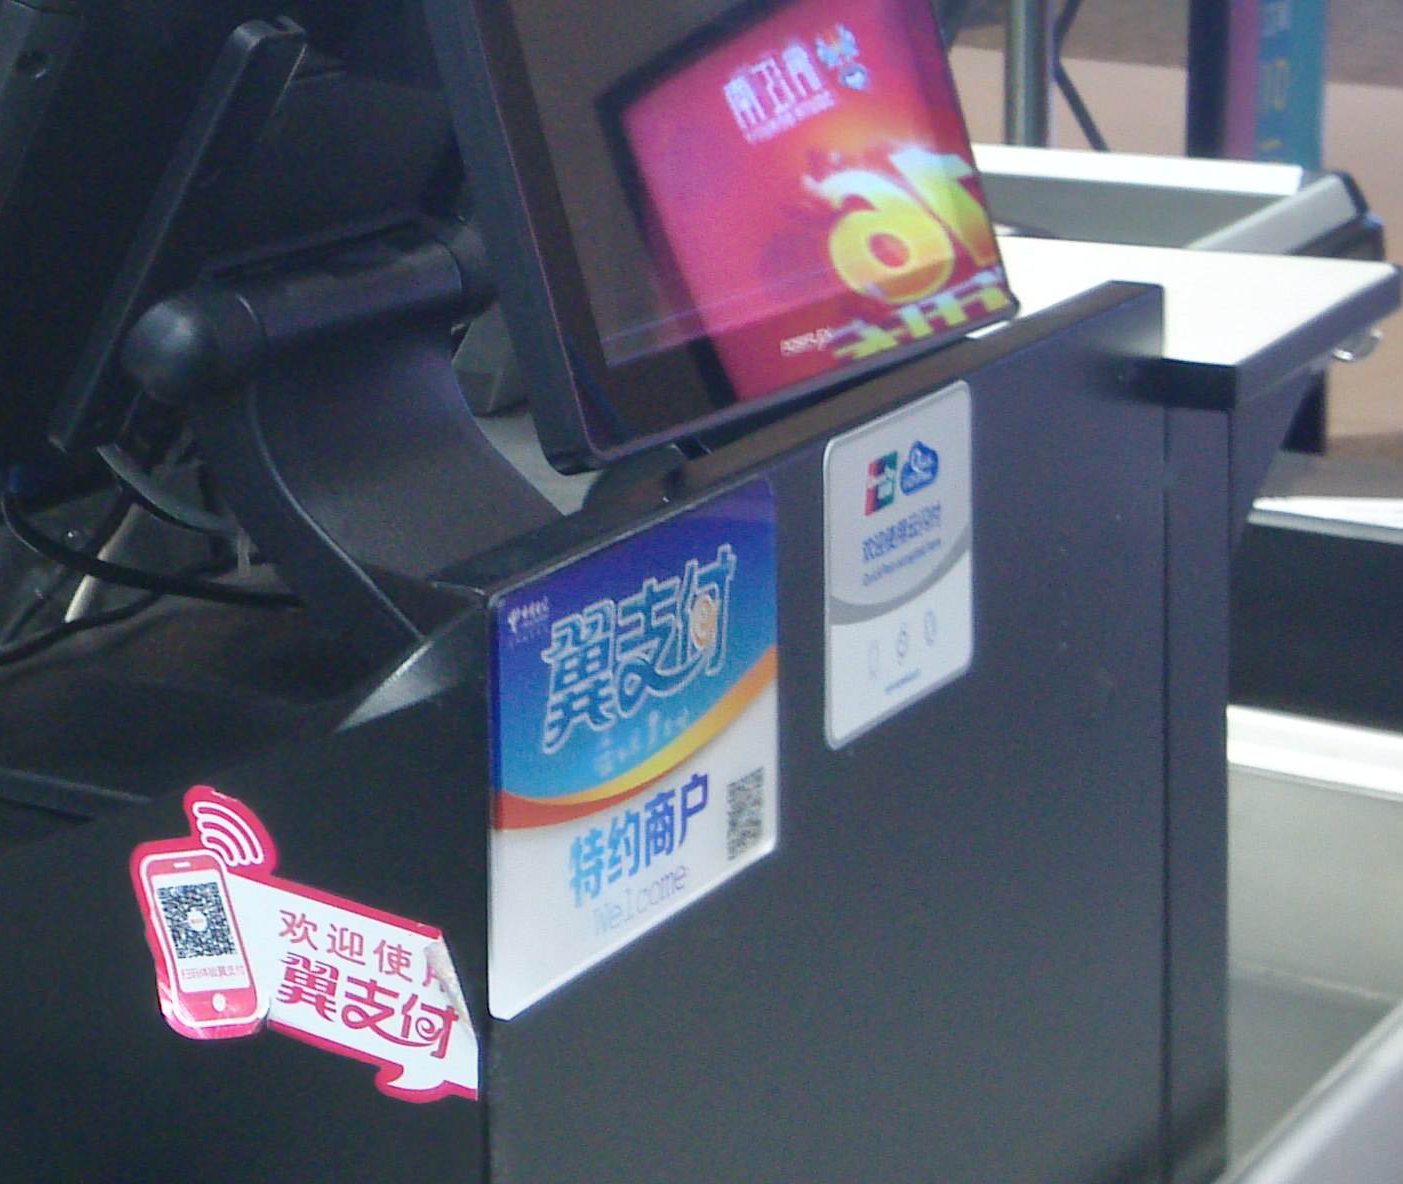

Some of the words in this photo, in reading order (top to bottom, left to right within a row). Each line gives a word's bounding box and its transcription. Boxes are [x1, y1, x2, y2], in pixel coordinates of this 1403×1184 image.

[542, 543, 738, 755] 翼支付
[569, 772, 709, 909] 特约商户
[275, 951, 460, 1060] 翼支付
